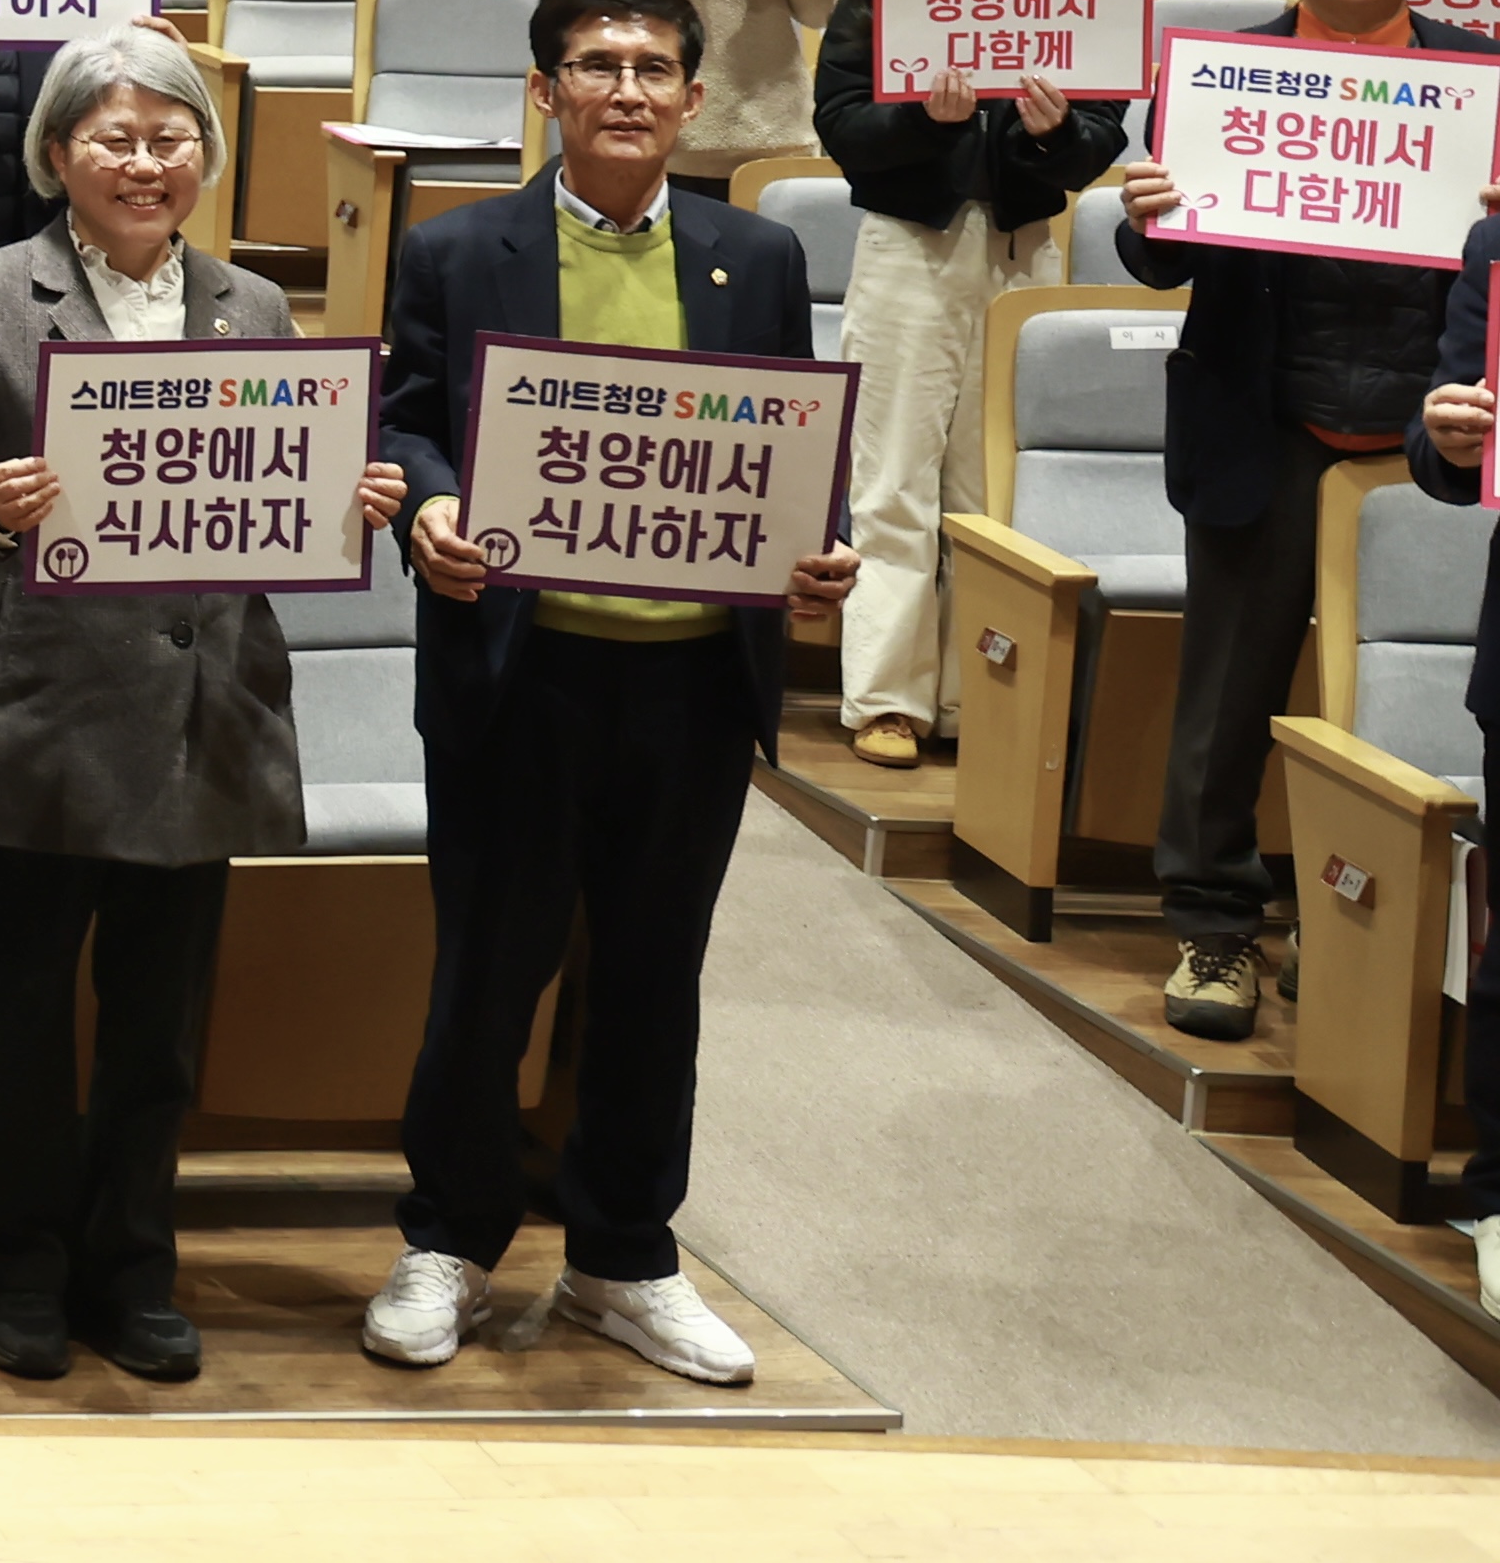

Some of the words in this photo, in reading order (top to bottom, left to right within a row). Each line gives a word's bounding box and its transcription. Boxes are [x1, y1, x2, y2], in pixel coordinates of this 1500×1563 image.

[948, 30, 1072, 72] 다함께
[1191, 64, 1332, 99] 스마트청양
[1221, 106, 1434, 172] 청양에서
[1244, 169, 1401, 229] 다함께
[71, 378, 212, 410] 스마트청양
[507, 376, 667, 417] 스마트청양
[101, 427, 309, 486] 청양에서
[538, 426, 772, 499] 청양에서
[95, 497, 312, 556] 식사하자
[529, 497, 767, 567] 식사하자
